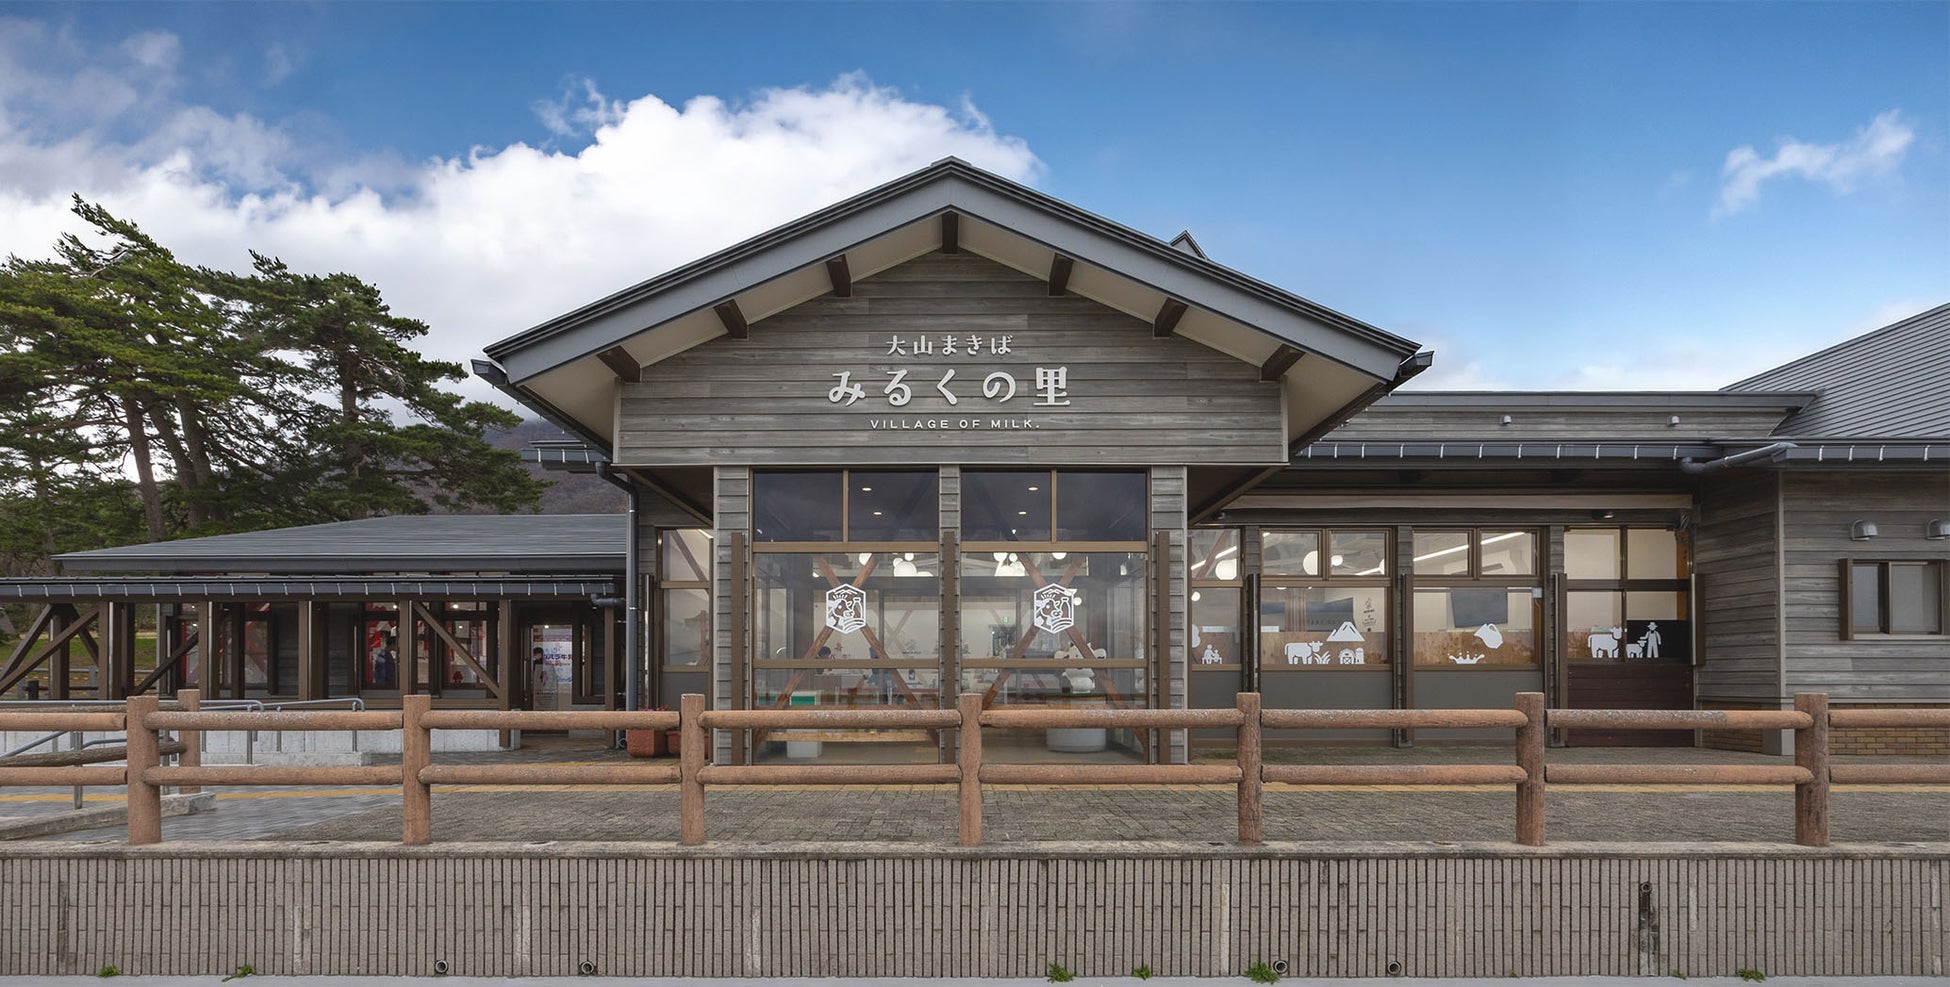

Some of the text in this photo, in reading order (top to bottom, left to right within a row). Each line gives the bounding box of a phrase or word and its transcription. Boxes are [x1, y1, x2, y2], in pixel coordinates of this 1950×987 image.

[886, 334, 1014, 356] 大山まきば
[828, 366, 1071, 407] みるくの里
[870, 419, 1040, 429] VILLAGE OF MILK.
